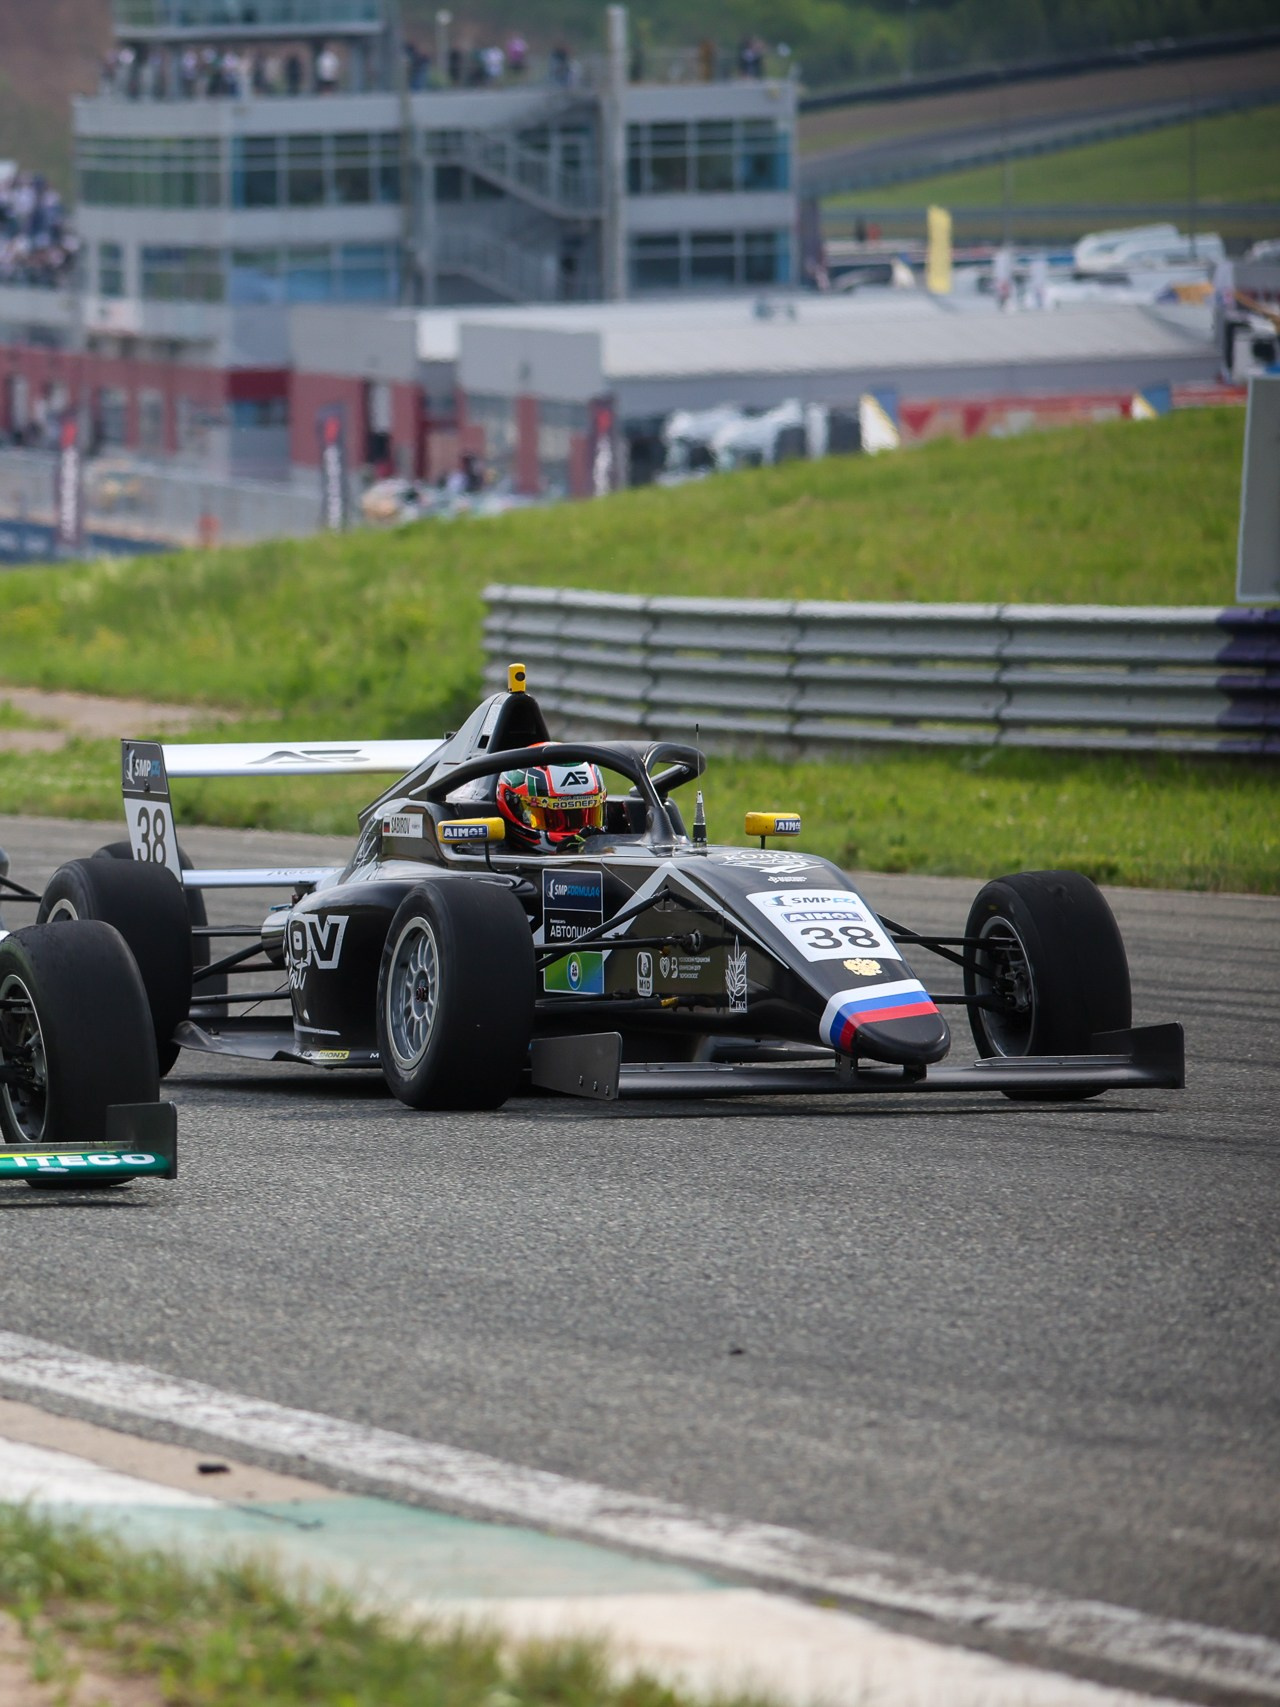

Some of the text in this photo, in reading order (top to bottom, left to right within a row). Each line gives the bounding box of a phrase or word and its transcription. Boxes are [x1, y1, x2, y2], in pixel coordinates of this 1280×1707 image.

[138, 806, 167, 866] 38
[444, 828, 487, 838] AIMOL
[789, 912, 859, 921] AIMOL
[800, 926, 881, 950] 38
[13, 1154, 156, 1167] ITECO
